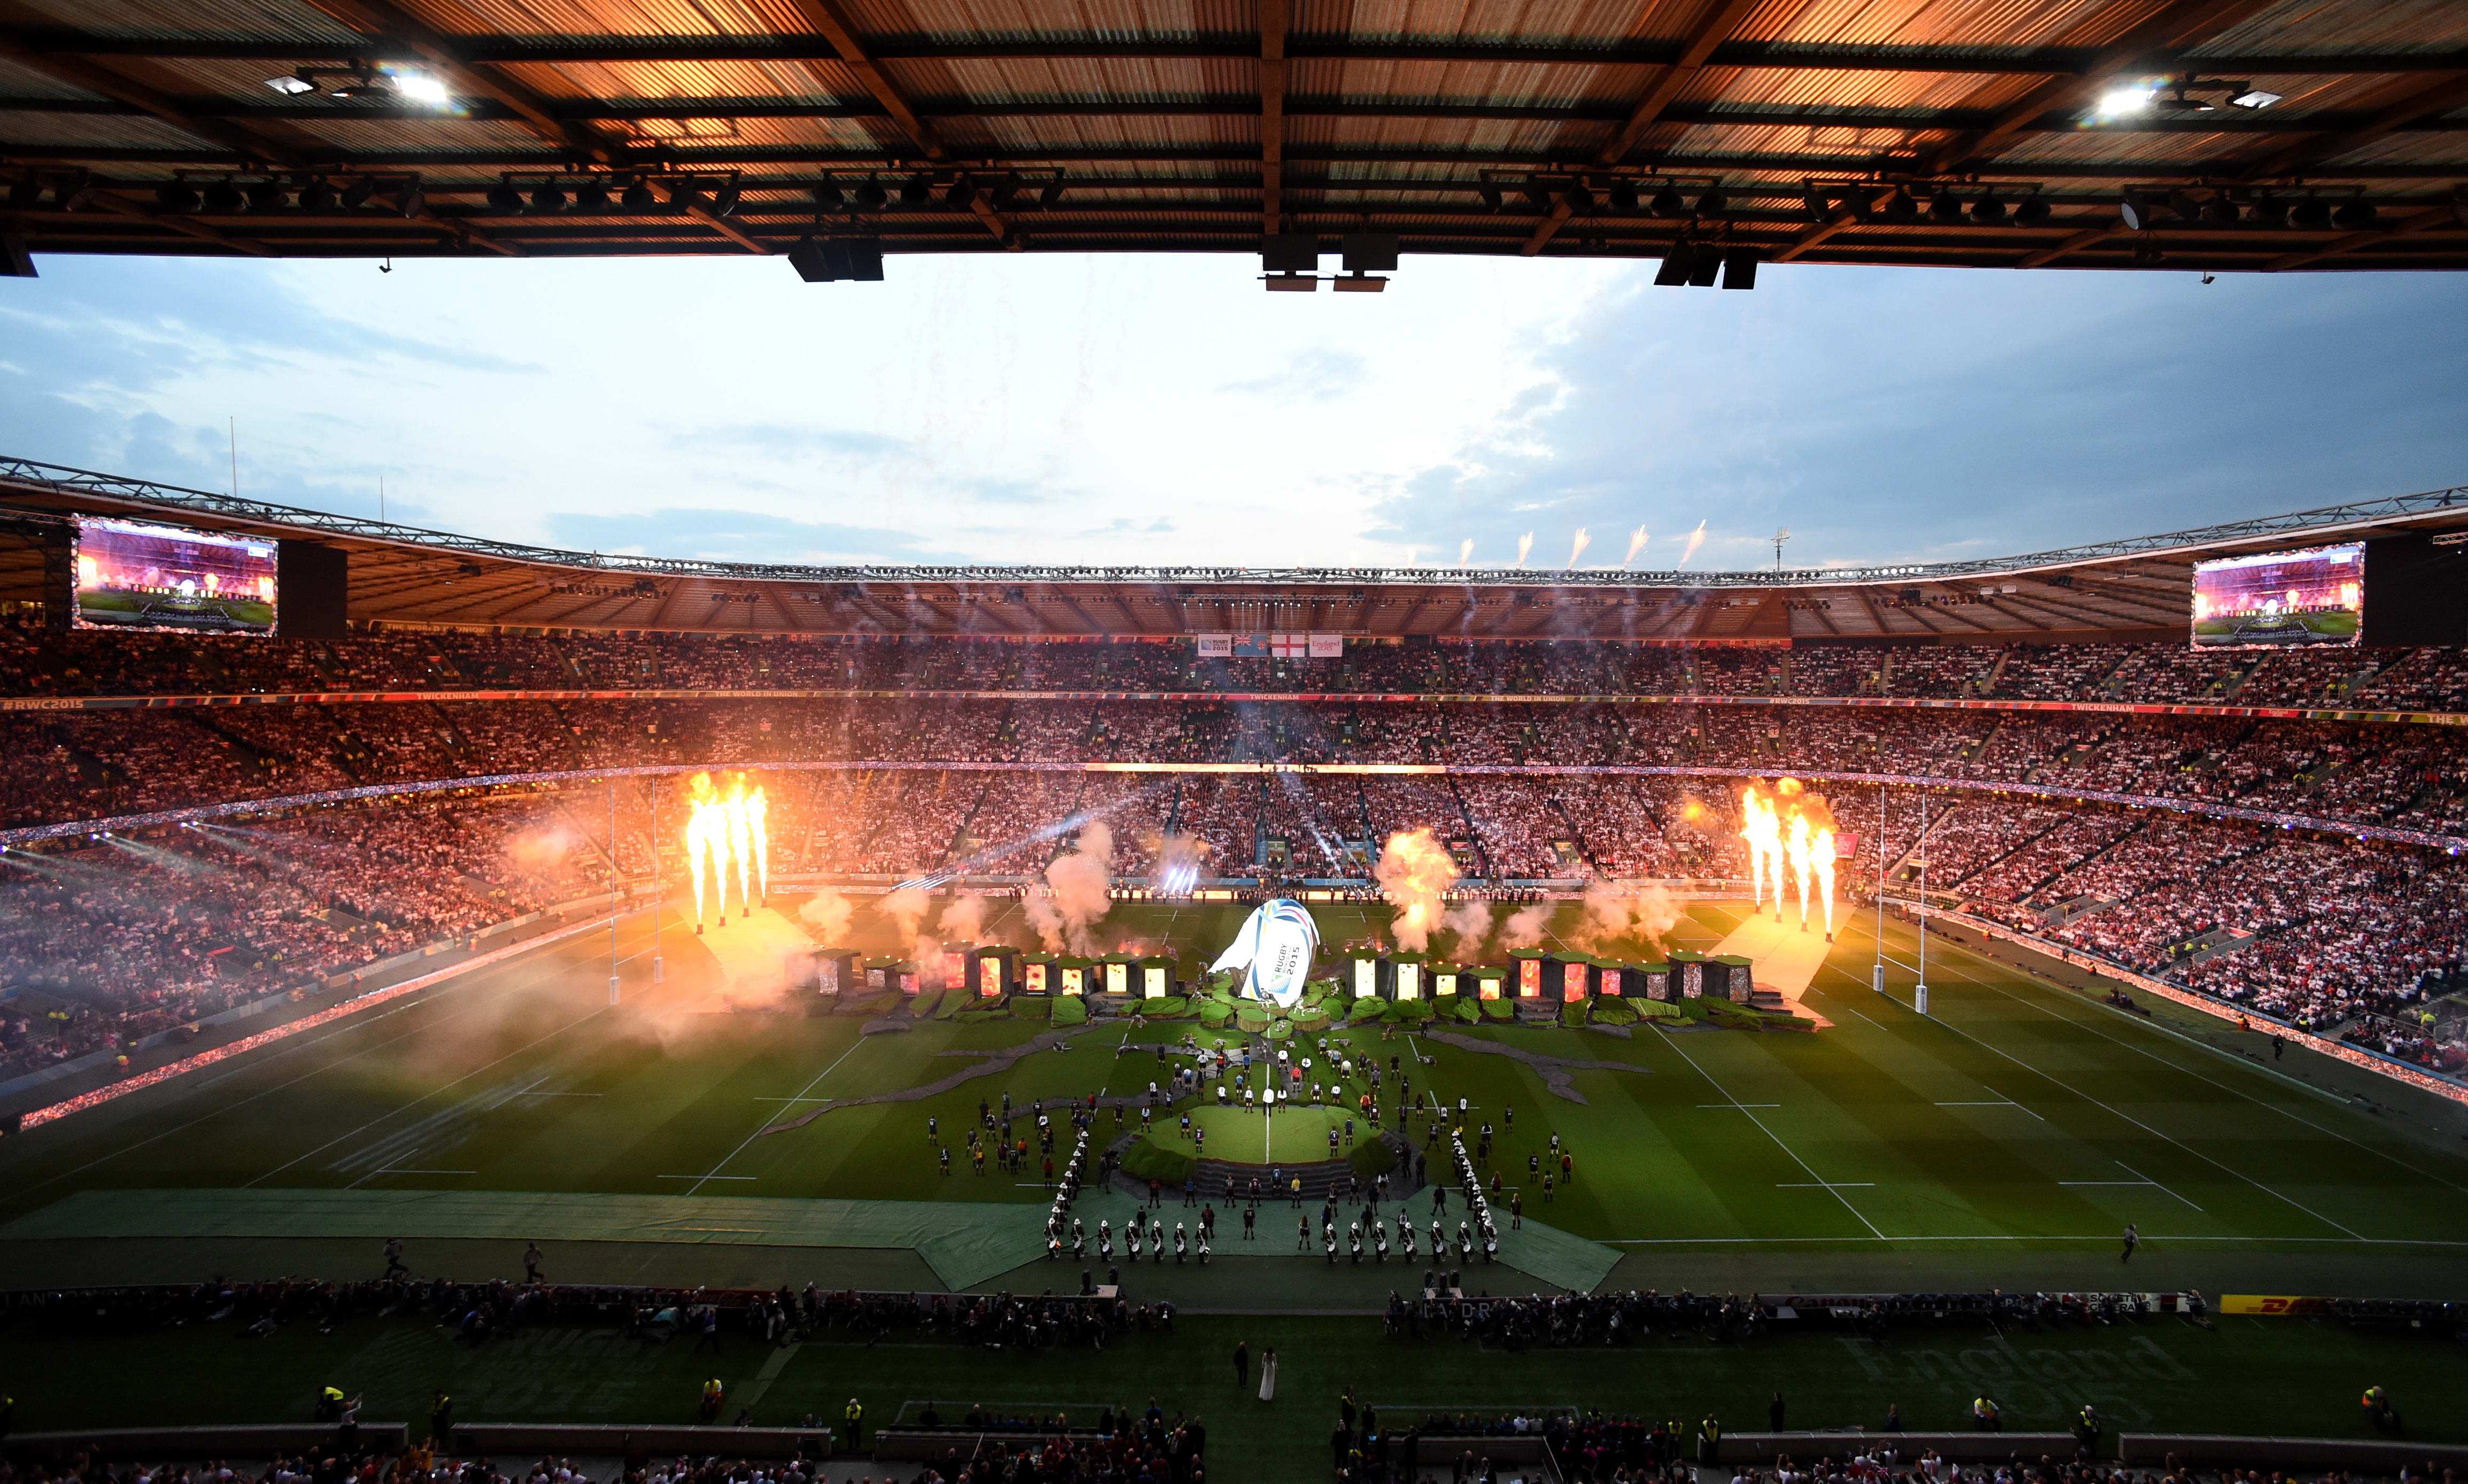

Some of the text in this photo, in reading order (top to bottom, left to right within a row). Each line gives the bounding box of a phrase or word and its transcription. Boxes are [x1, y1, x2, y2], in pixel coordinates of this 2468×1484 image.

[3, 700, 84, 710] #RWC2015
[2427, 715, 2454, 724] THE
[1275, 943, 1287, 973] RUGBY
[1286, 947, 1299, 975] 2015
[1785, 1296, 1865, 1308] Canon
[2261, 1299, 2328, 1313] DHL
[1424, 1302, 1473, 1318] LAD
[1835, 1335, 2199, 1383] England
